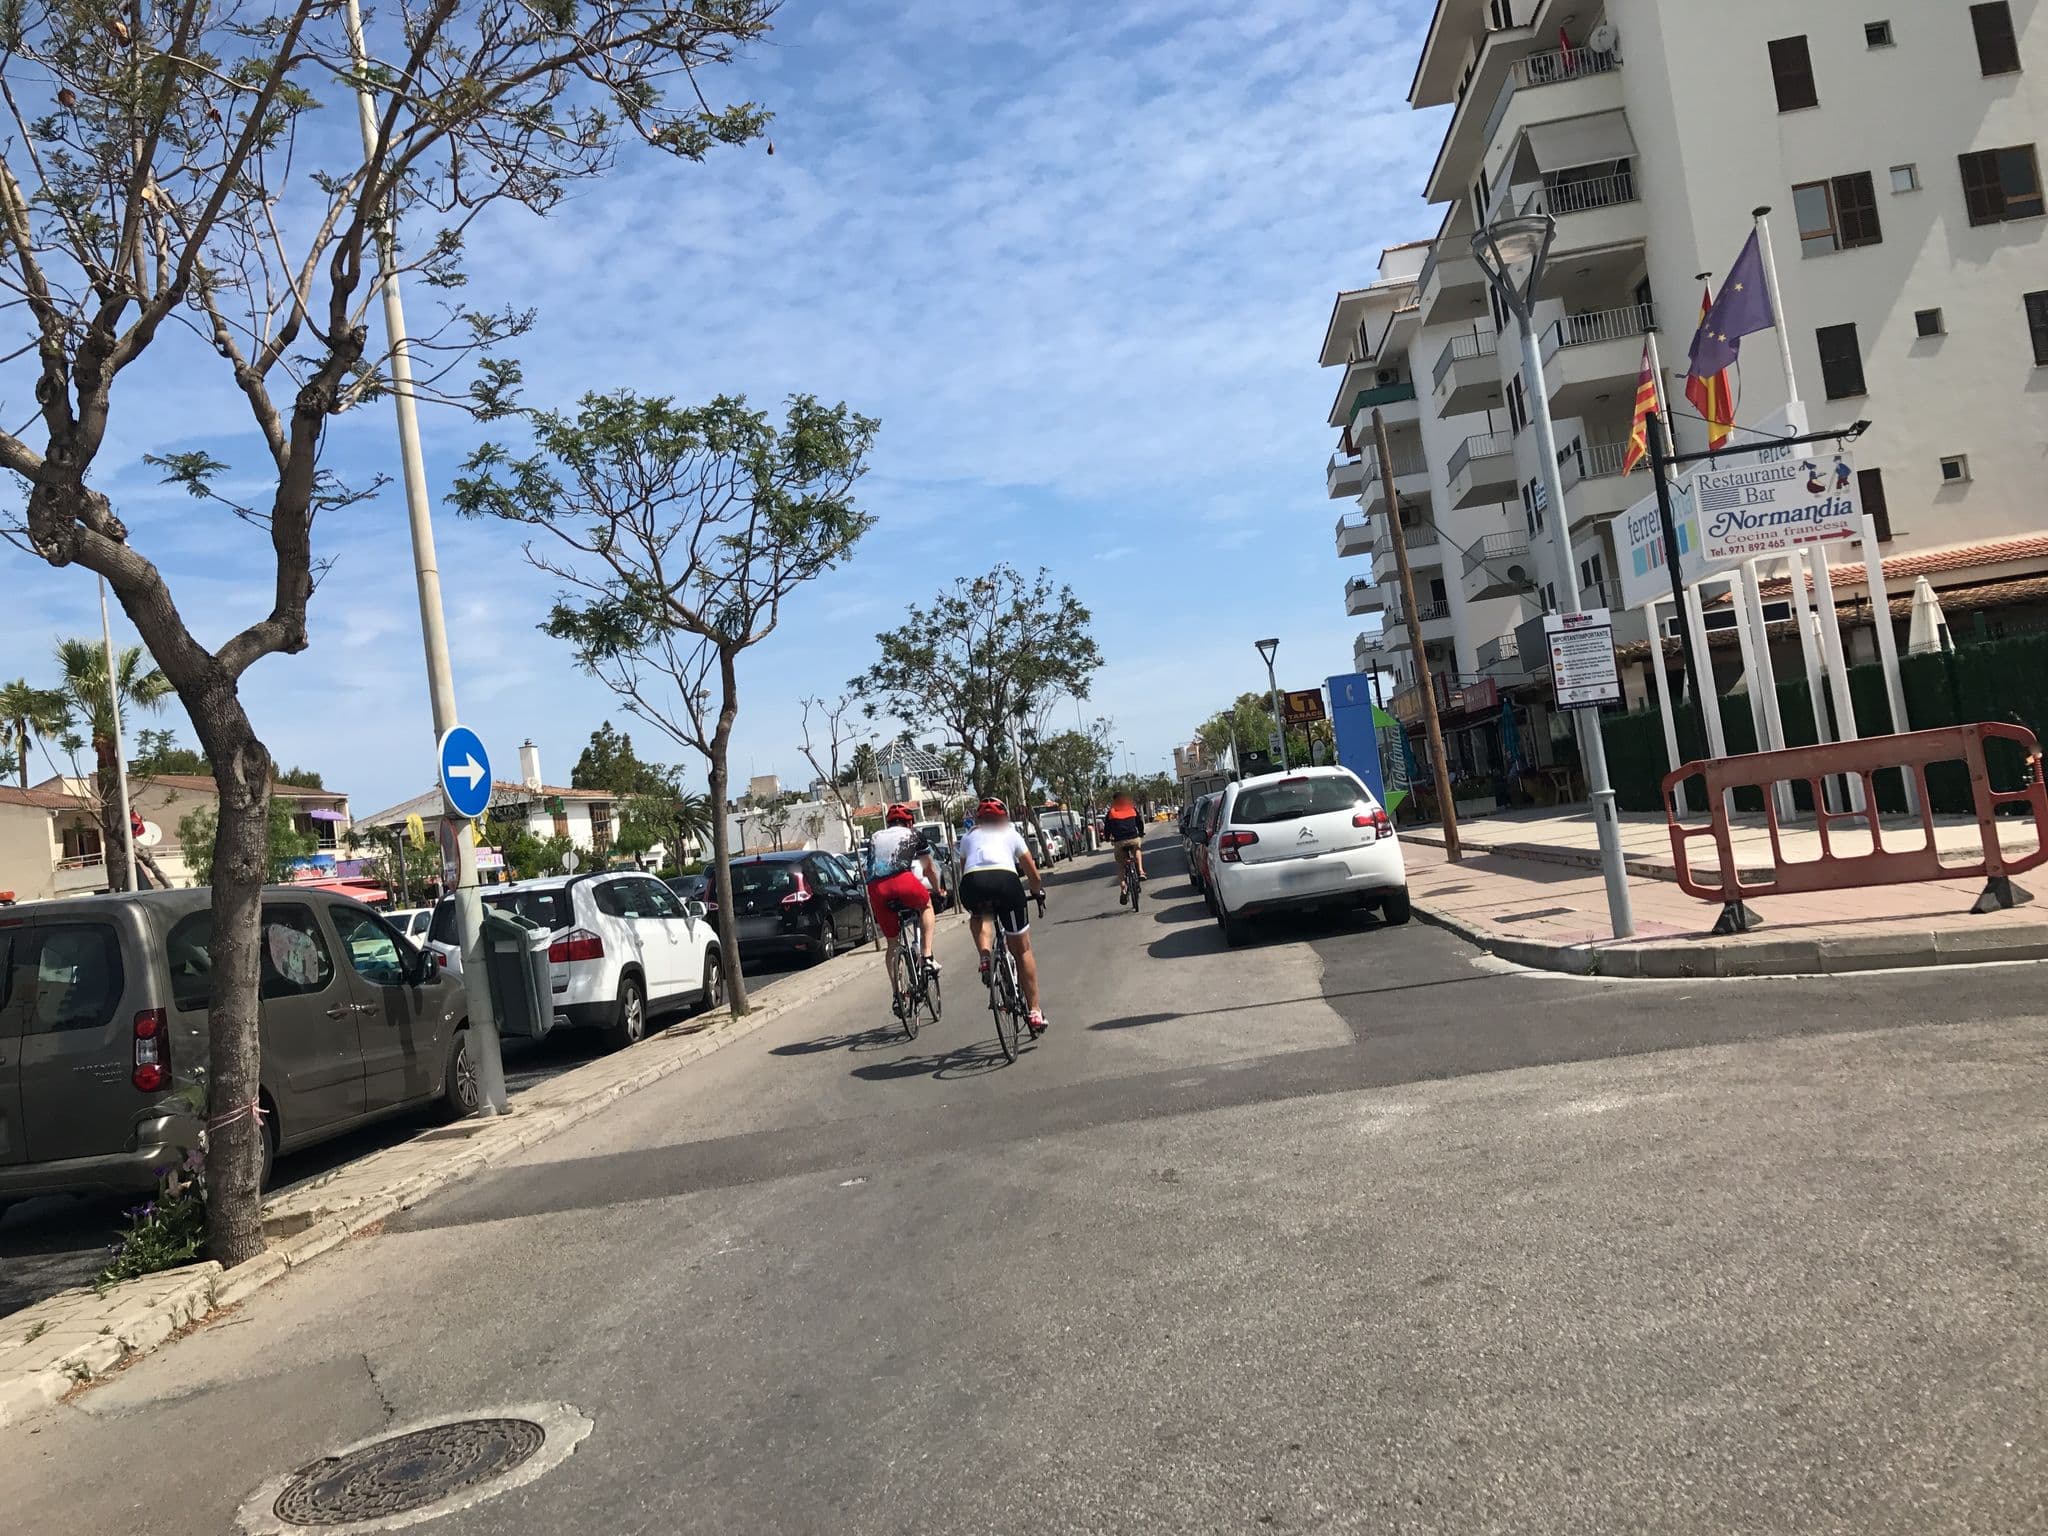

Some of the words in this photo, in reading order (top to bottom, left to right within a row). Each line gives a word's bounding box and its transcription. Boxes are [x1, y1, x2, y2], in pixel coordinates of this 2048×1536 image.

[1699, 465, 1796, 490] Restaurante
[1746, 487, 1776, 503] Bar
[1627, 509, 1661, 546] ferrer
[1708, 497, 1853, 538] Normandia
[1724, 530, 1778, 545] Cocina
[1784, 520, 1848, 537] francesa
[1711, 548, 1727, 558] Tel.
[1729, 544, 1746, 555] 971
[1749, 542, 1766, 552] 892
[1768, 538, 1786, 549] 465
